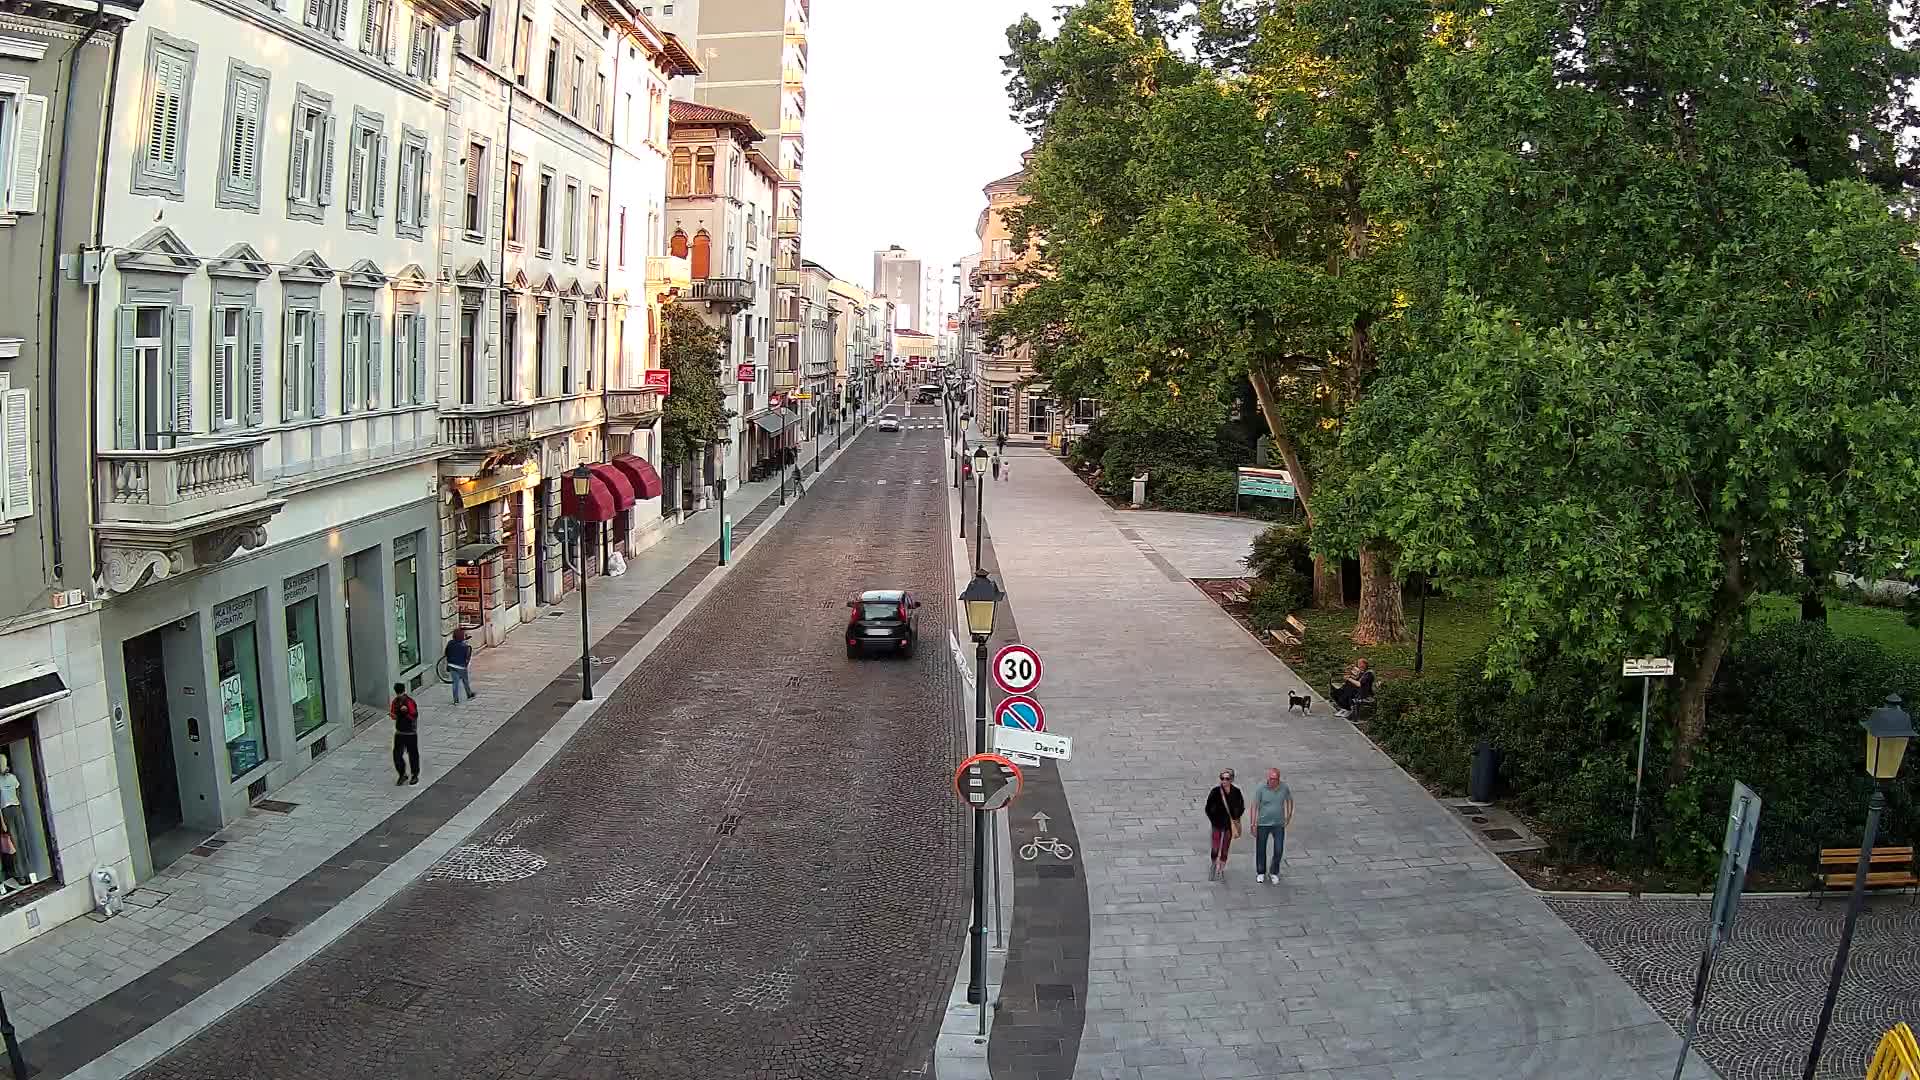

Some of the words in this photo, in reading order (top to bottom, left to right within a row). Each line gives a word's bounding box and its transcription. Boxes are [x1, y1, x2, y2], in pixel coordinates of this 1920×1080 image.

[1004, 658, 1032, 680] 30
[221, 678, 240, 701] 130
[1034, 742, 1065, 755] Dante
